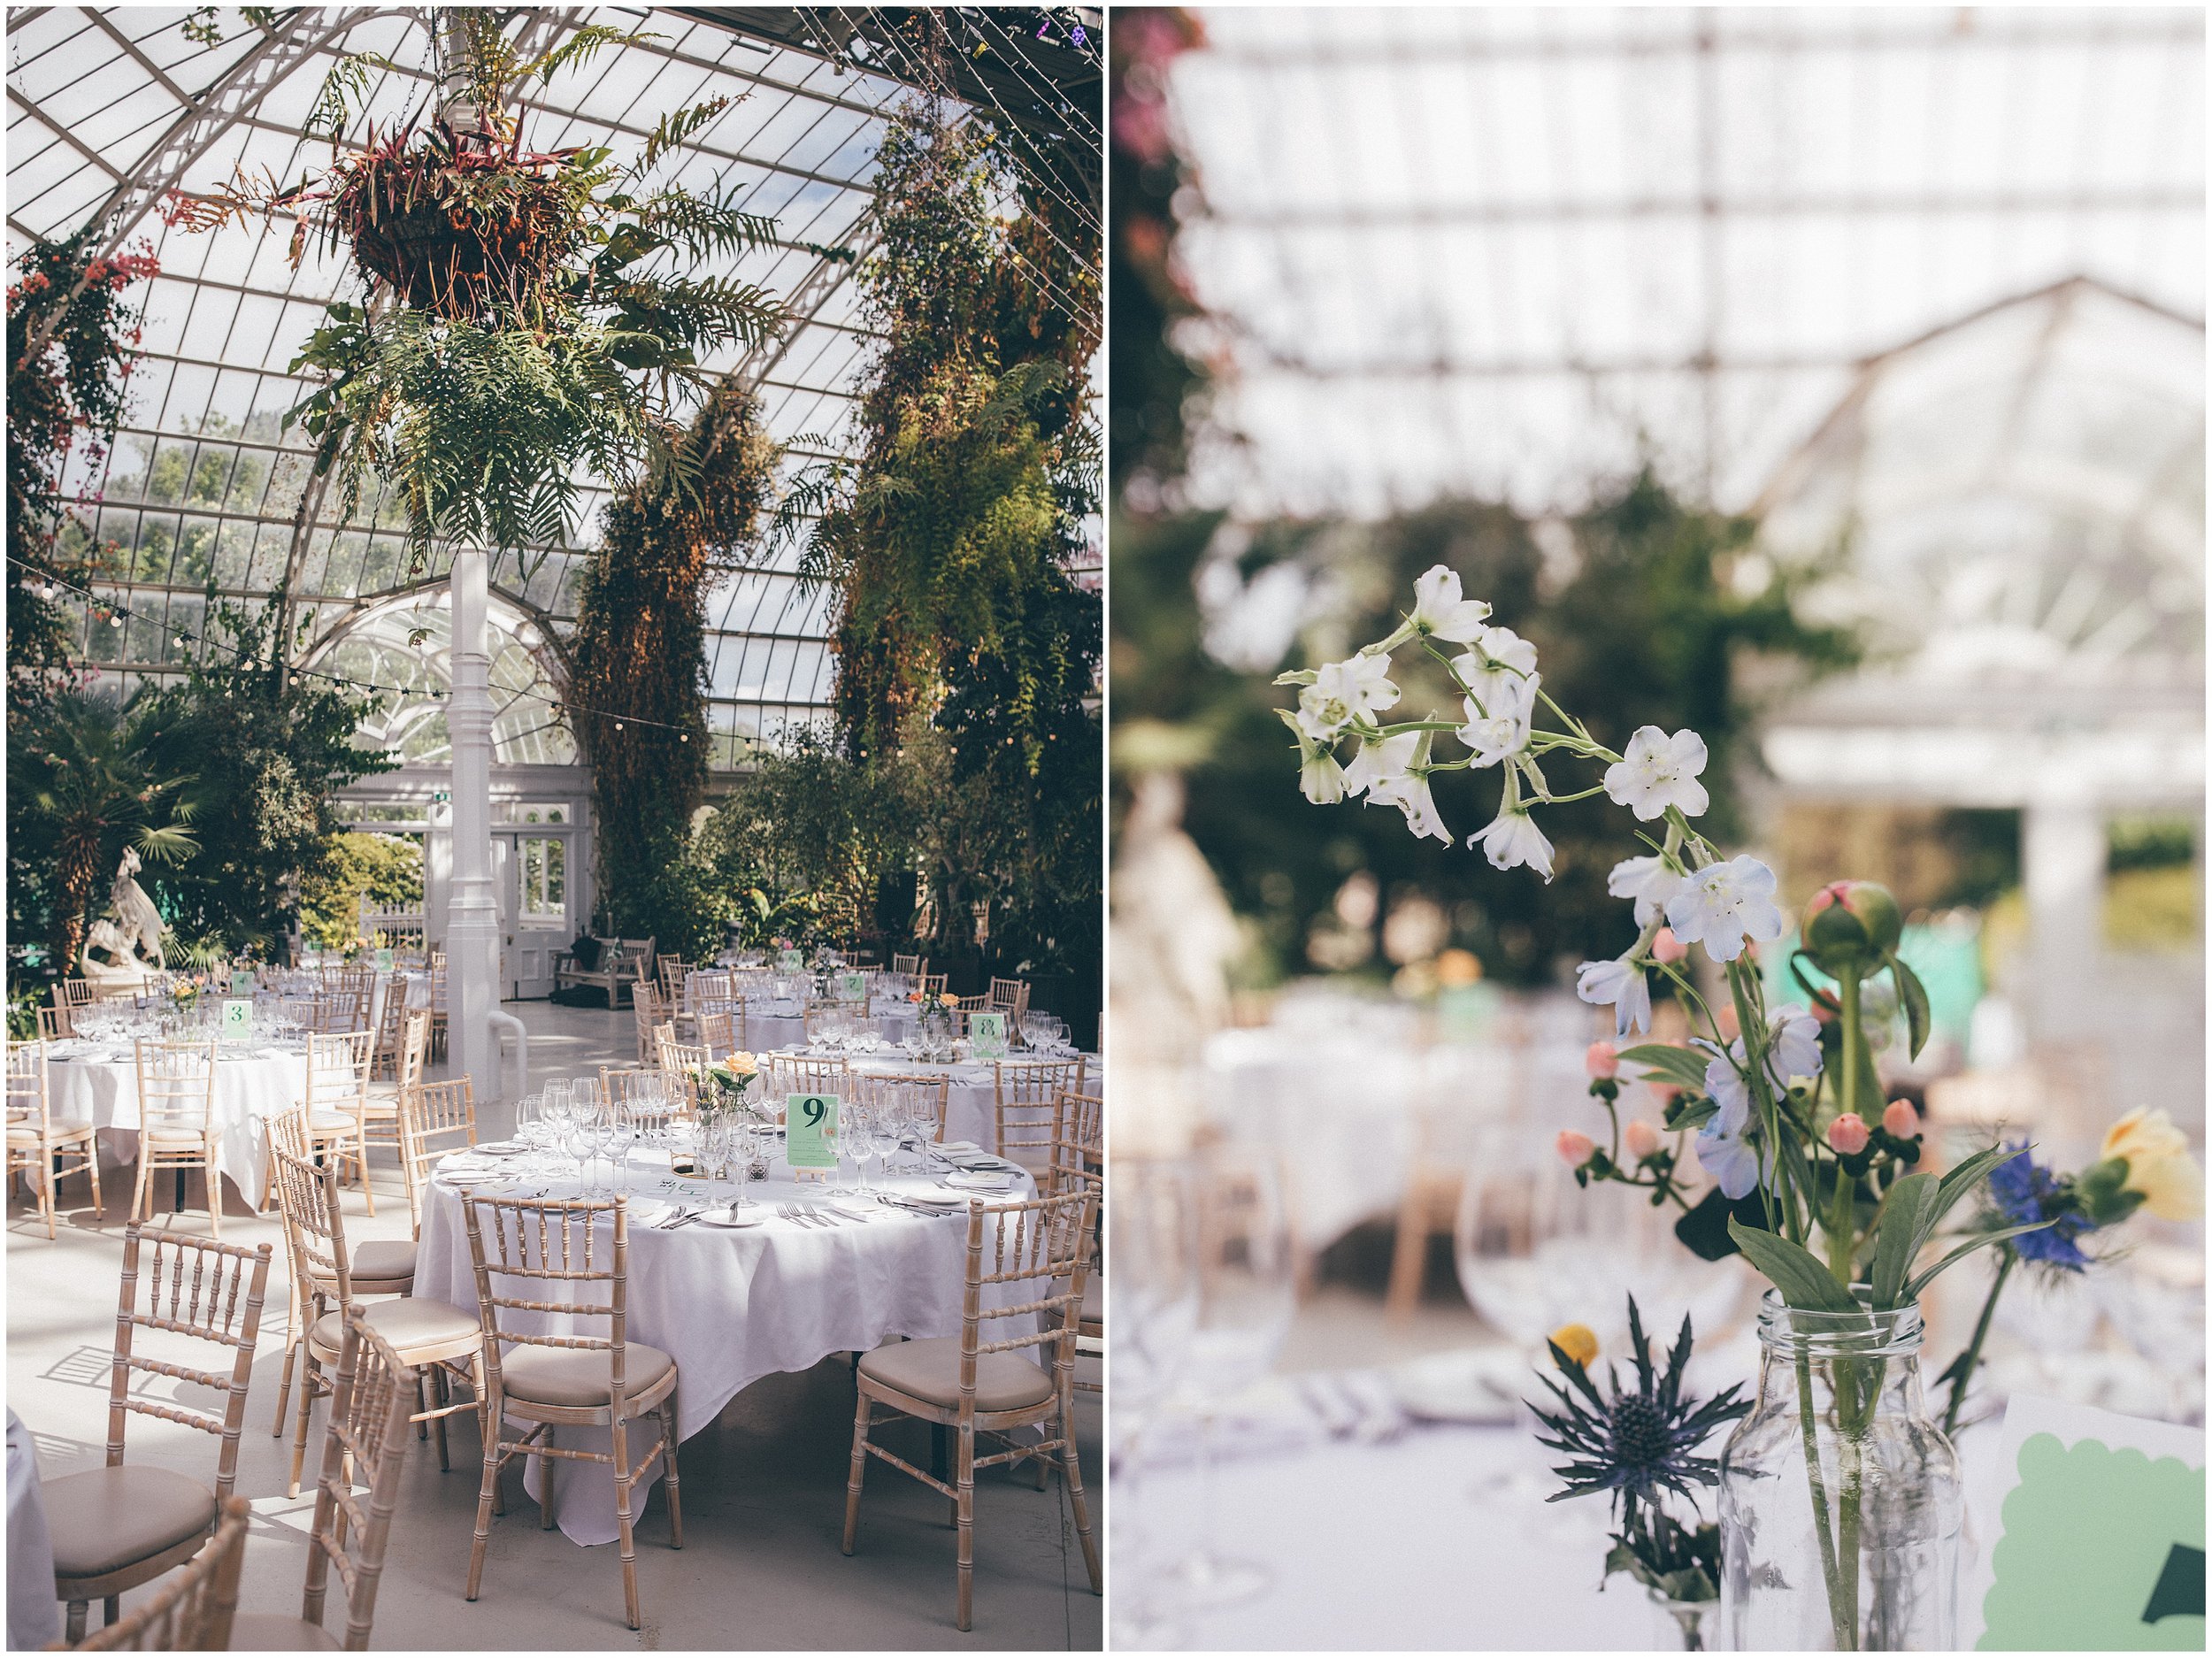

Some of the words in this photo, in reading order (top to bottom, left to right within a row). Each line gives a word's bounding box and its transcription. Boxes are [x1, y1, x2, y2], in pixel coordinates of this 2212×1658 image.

[849, 978, 856, 989] 7
[231, 1005, 242, 1022] 3
[981, 1018, 995, 1036] 8
[803, 1098, 825, 1128] 9
